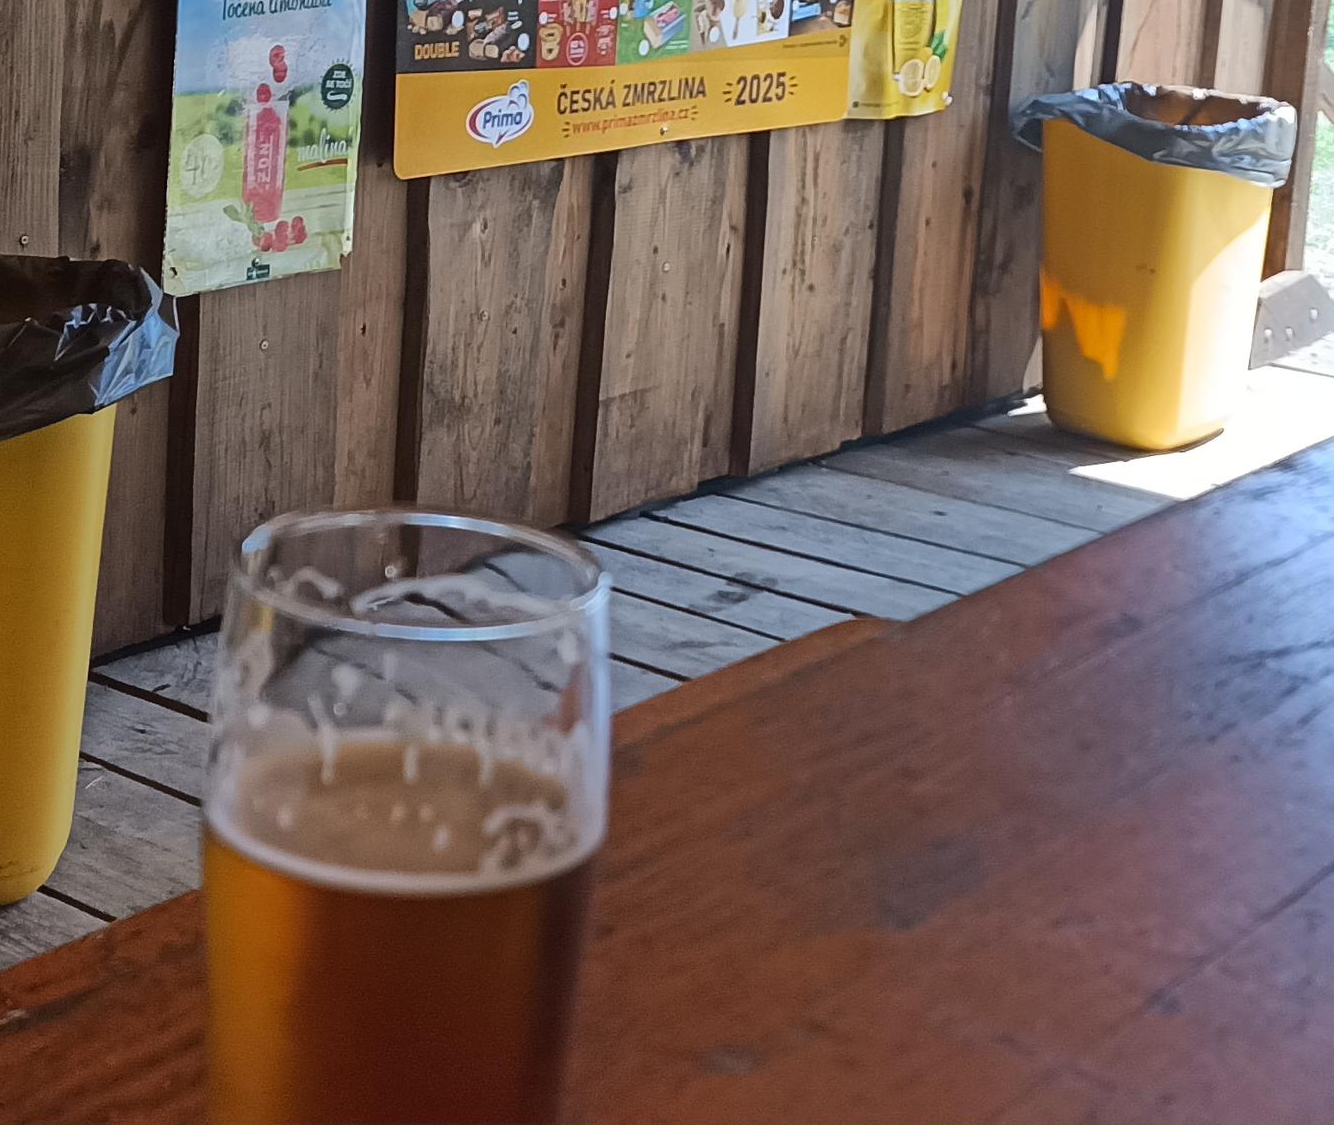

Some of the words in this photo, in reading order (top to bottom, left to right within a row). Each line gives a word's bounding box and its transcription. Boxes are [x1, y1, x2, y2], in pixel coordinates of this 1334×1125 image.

[557, 79, 617, 115] ČESKÁ
[621, 76, 707, 108] ZMRZLINA
[734, 72, 787, 106] 2025
[482, 109, 523, 130] Prima
